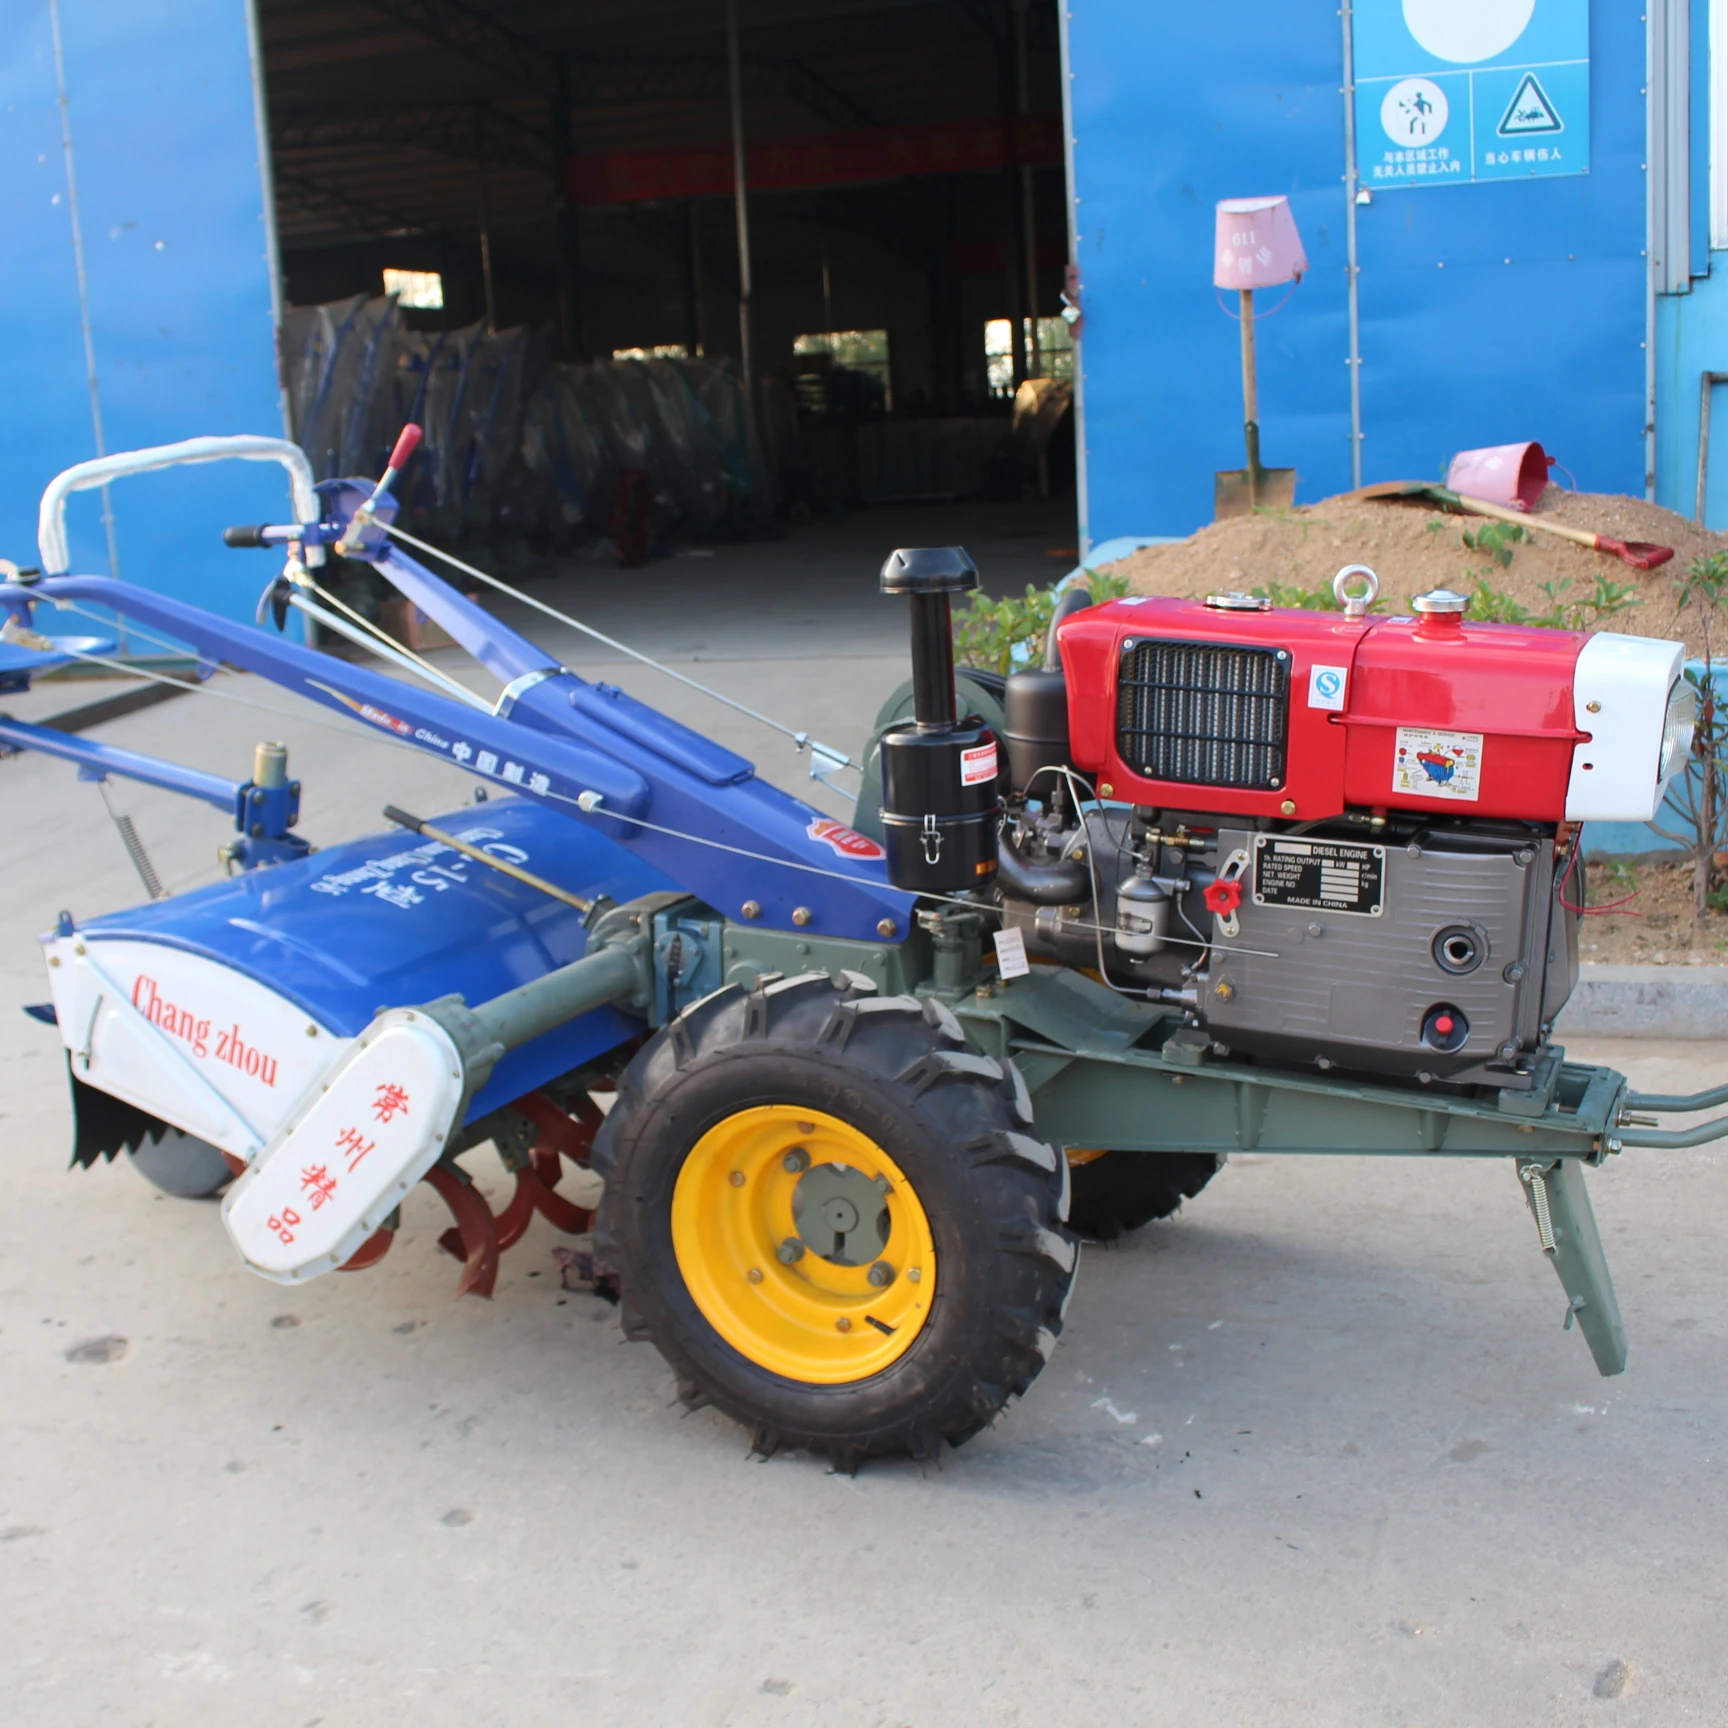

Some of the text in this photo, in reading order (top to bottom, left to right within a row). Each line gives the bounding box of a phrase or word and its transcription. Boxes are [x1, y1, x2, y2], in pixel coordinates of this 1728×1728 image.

[1383, 147, 1450, 163] 与本区域工作
[1485, 147, 1562, 165] 当心车辆伤人
[1373, 160, 1461, 178] 无关人员禁止入内
[414, 727, 450, 749] China
[451, 740, 551, 796] 中国制造
[1313, 846, 1368, 860] DIESEL ENGINE
[1263, 862, 1378, 880] RATED SPEED r/min
[1273, 855, 1295, 863] RATING
[1296, 858, 1321, 866] OUTPUT
[1362, 863, 1371, 871] HP
[1262, 879, 1284, 887] ENGINE
[1277, 872, 1301, 880] WEIGHT
[1361, 880, 1369, 888] kg
[1287, 896, 1311, 905] MADE
[1322, 900, 1348, 909] CHINA
[131, 974, 279, 1088] Chang zhou
[267, 1082, 411, 1245] 常州精品
